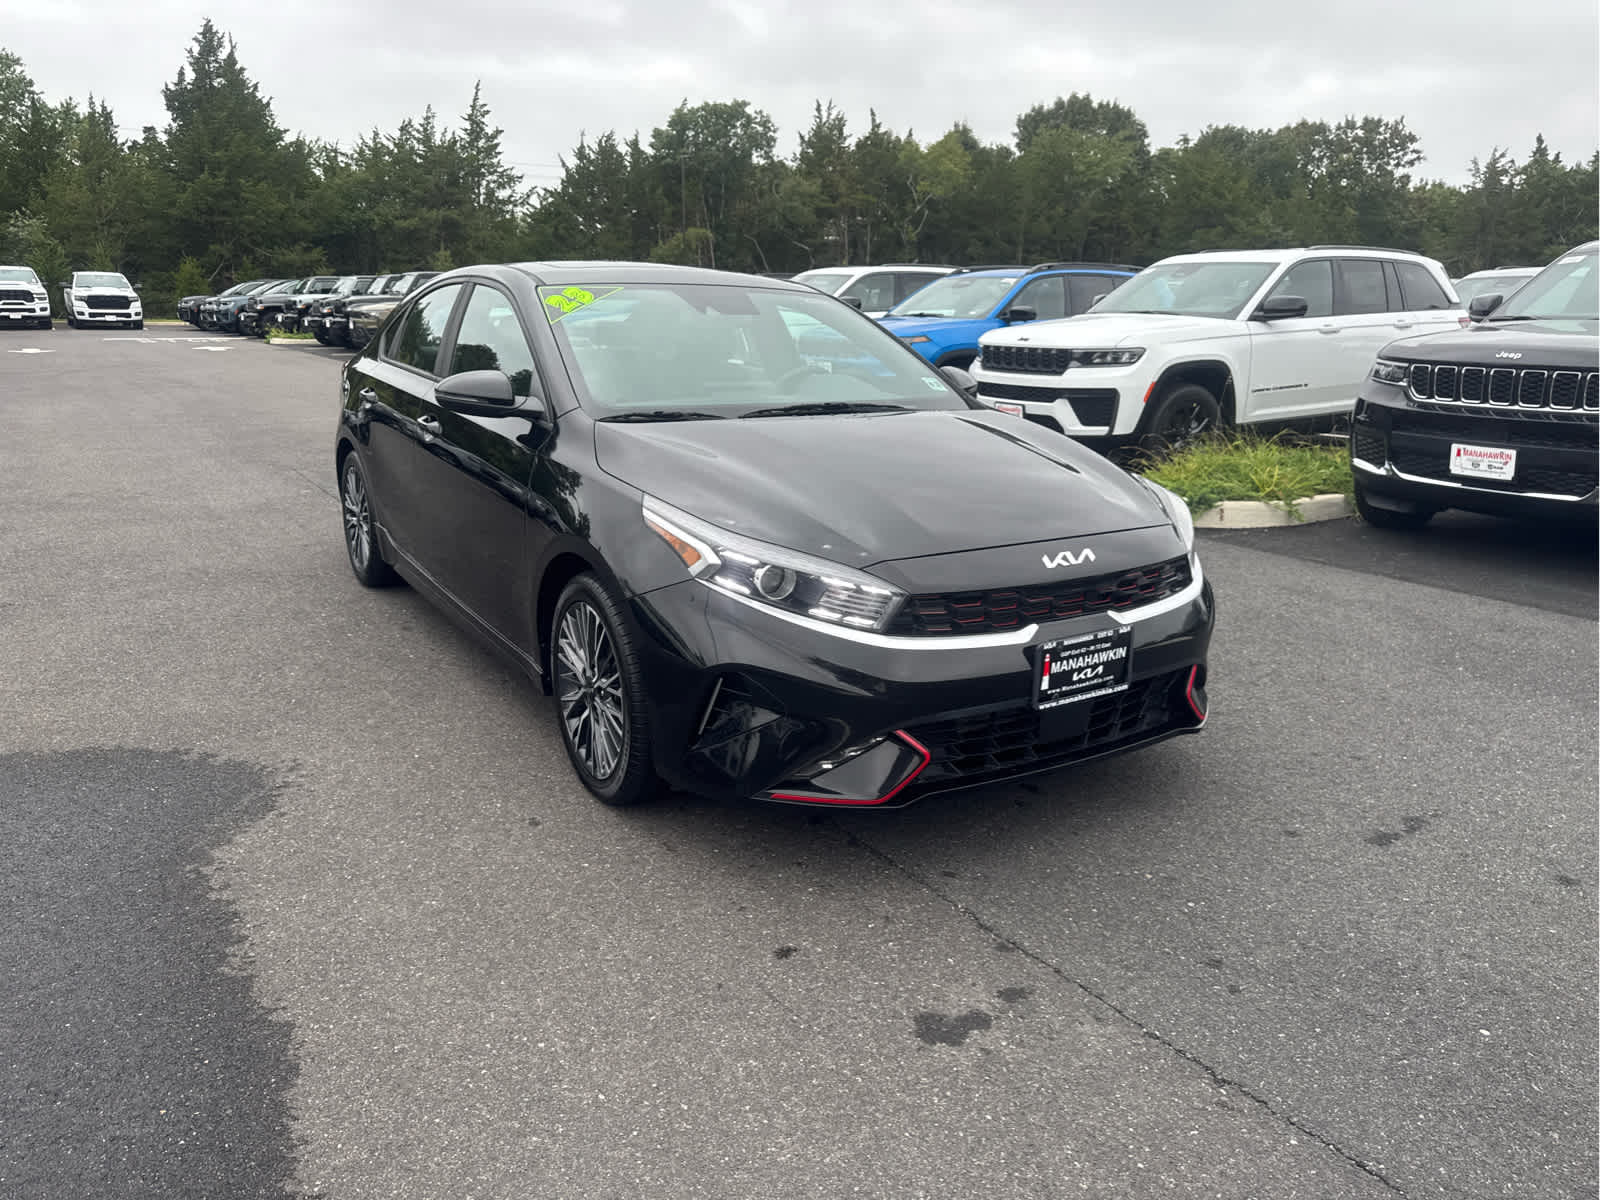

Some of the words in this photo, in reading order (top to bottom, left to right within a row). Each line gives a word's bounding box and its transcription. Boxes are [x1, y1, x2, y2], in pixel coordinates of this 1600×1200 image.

[544, 287, 594, 313] 23
[1495, 351, 1522, 360] Jeep
[1041, 547, 1096, 569] KIA
[1050, 646, 1128, 675] MANAHAWKIN
[1072, 665, 1104, 681] KIA
[1039, 684, 1129, 710] www.manahawkinkia.com
